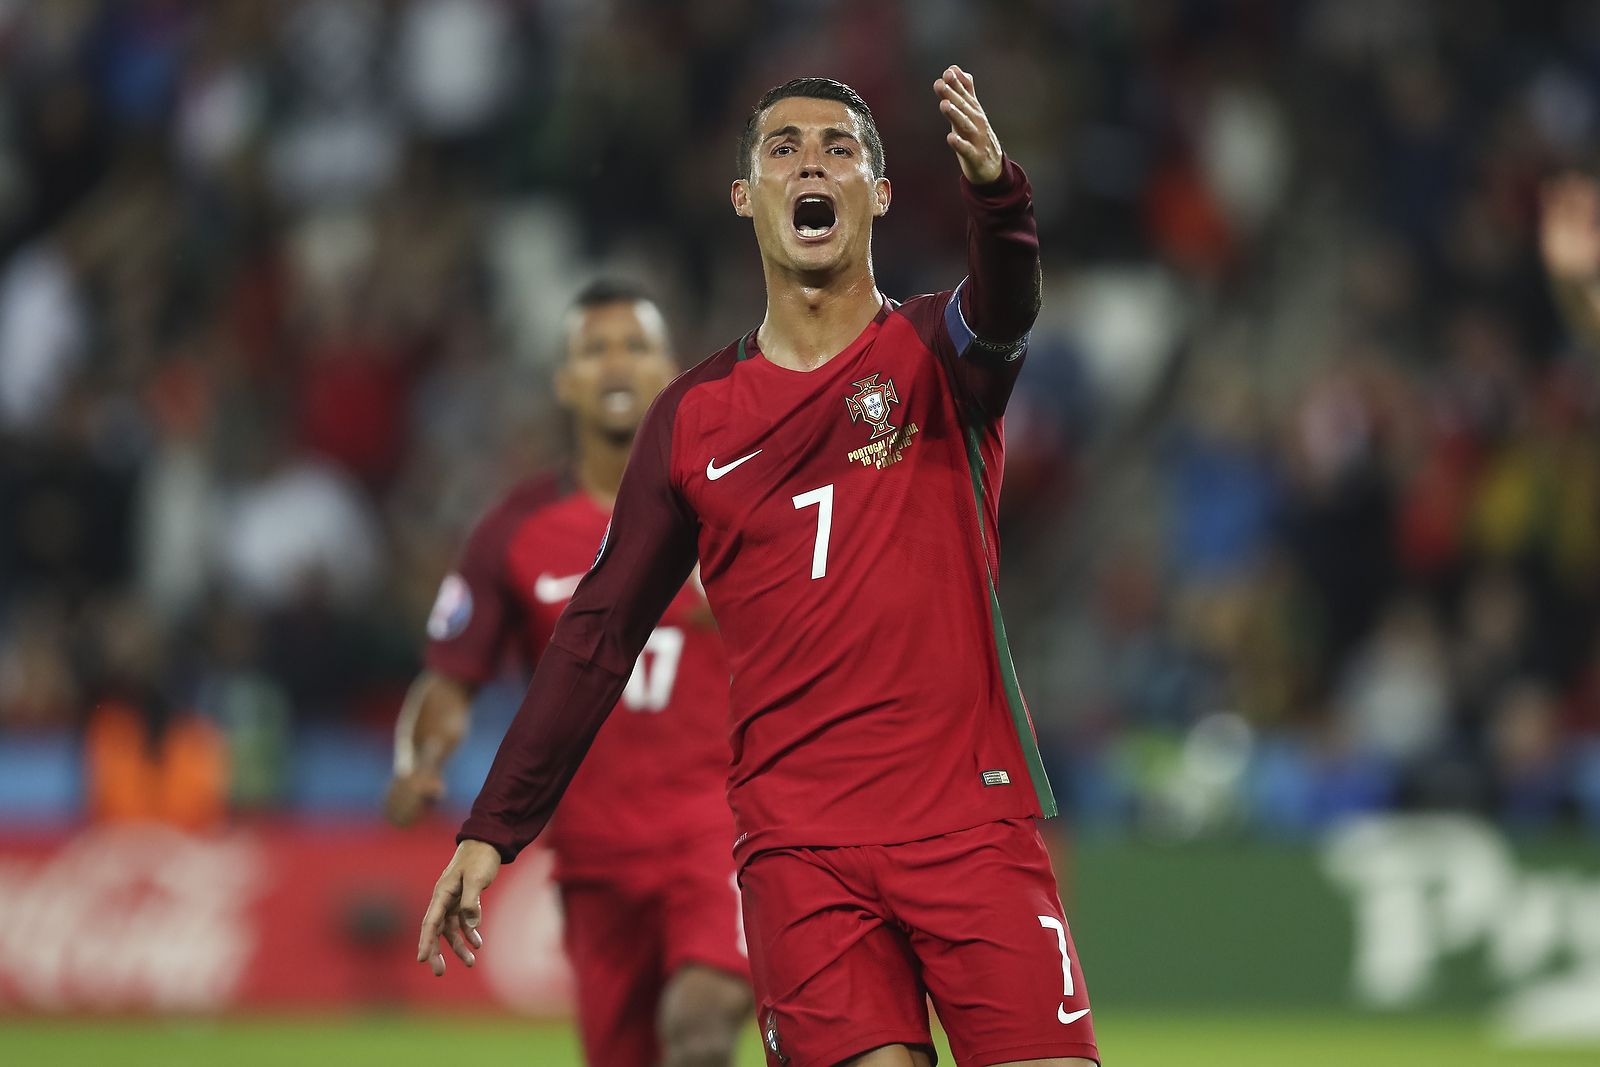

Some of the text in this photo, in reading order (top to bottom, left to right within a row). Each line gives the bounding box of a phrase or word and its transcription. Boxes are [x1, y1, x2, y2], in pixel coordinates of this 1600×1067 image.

[875, 450, 903, 470] PARIS
[791, 483, 834, 580] 7
[1037, 915, 1074, 996] 7
